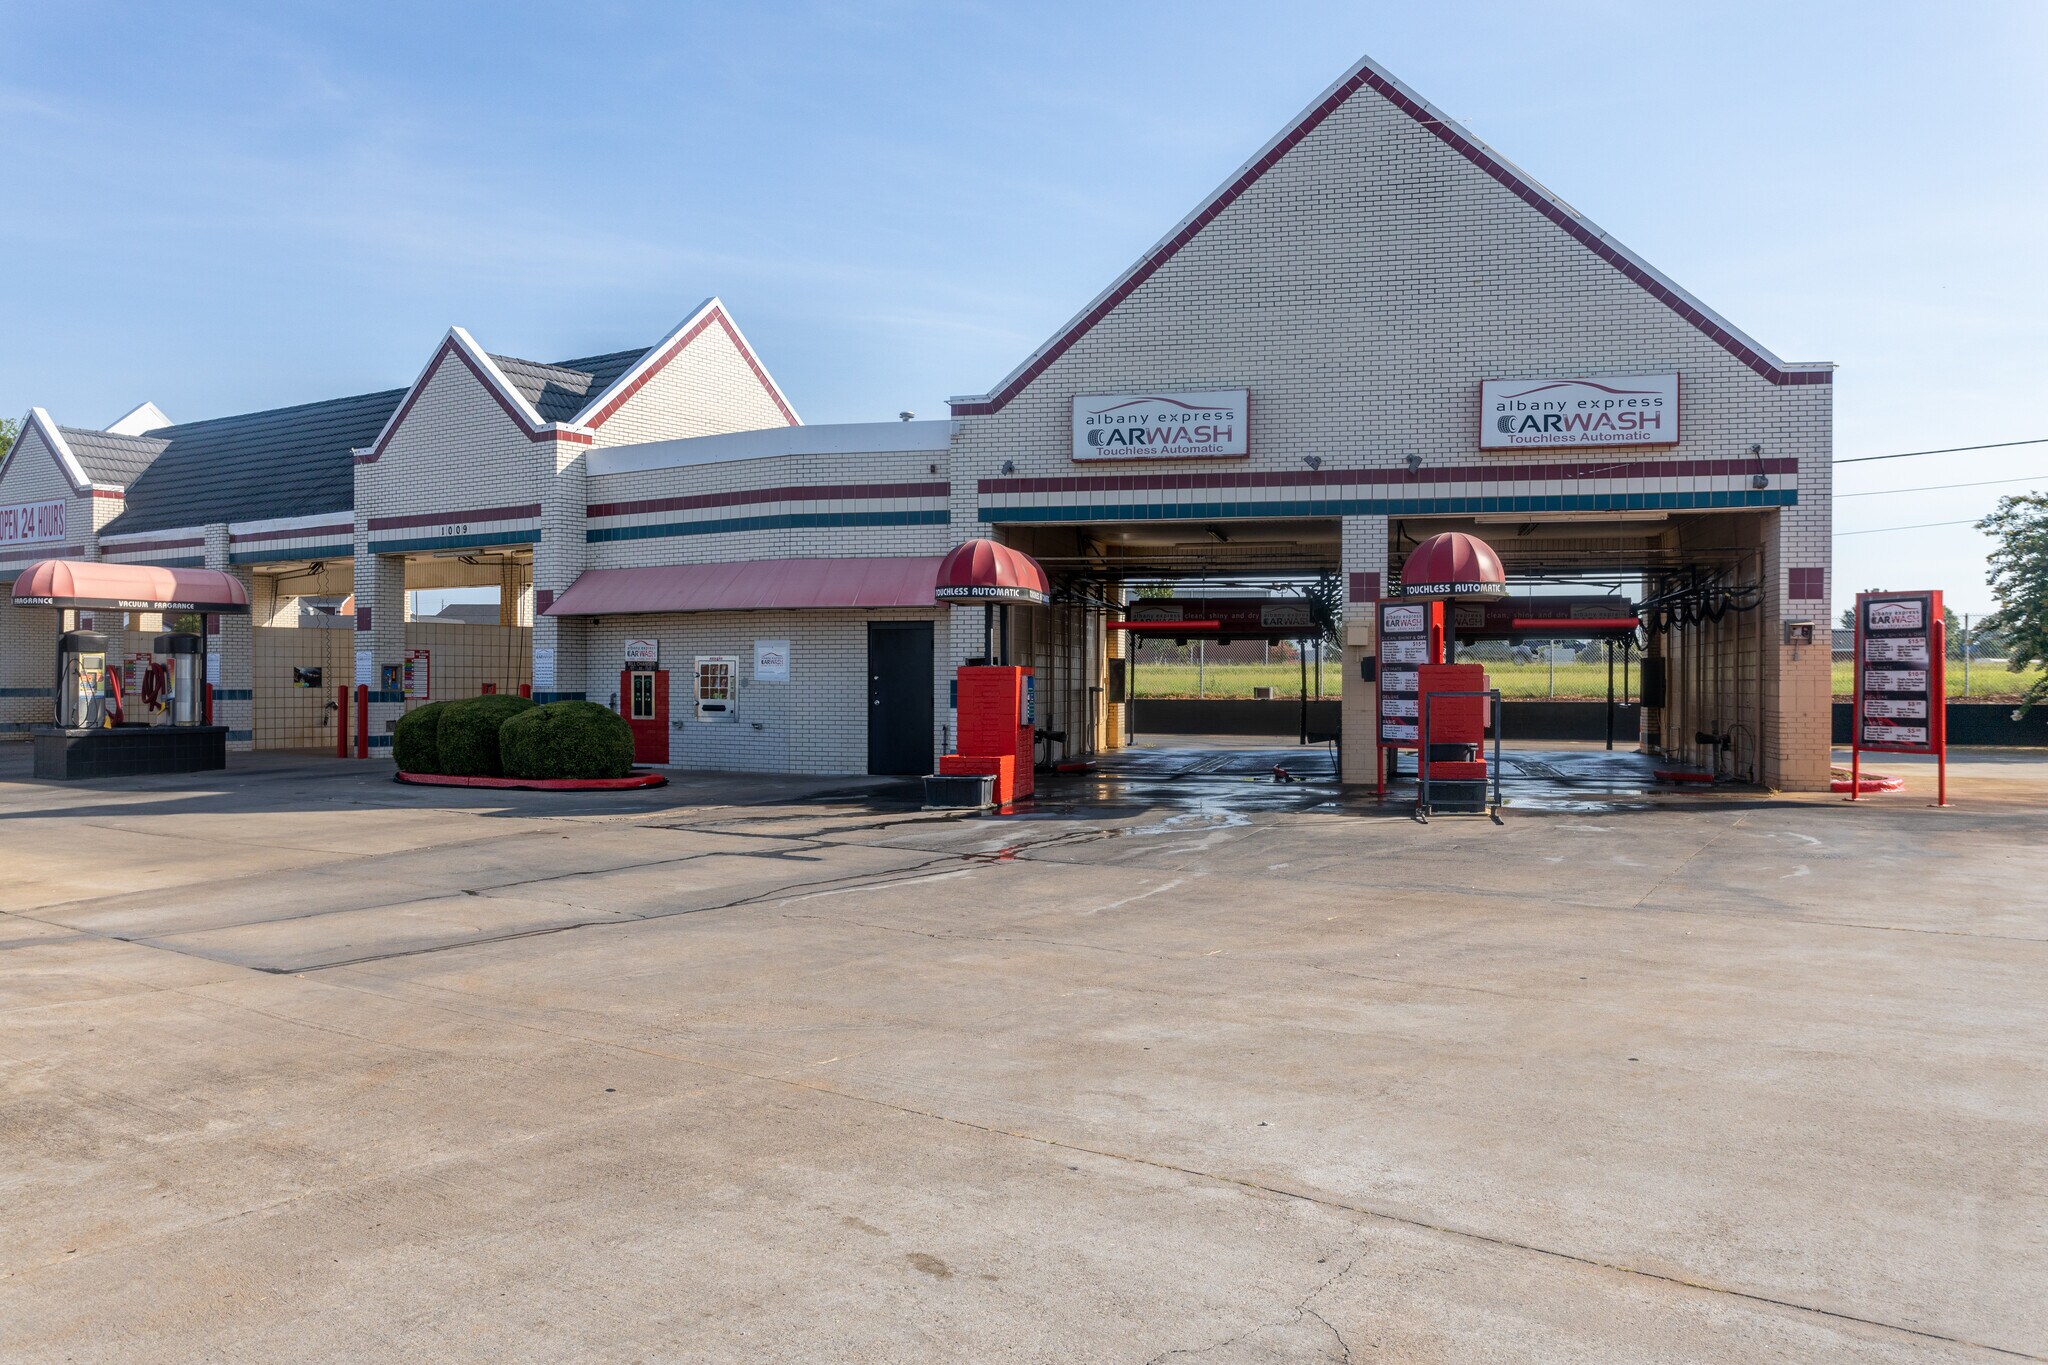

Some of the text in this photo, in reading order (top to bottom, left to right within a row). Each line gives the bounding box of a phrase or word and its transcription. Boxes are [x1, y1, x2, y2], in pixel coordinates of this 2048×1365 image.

[1496, 397, 1663, 411] albany express
[1086, 411, 1234, 425] albany express
[1497, 410, 1661, 434] CARWASH
[1087, 425, 1232, 447] CARWASH
[1508, 431, 1650, 444] Touchless Automatic
[1096, 444, 1223, 456] Touchless Automatic
[0, 504, 64, 540] OPEN 24 HOURS
[441, 524, 468, 536] 1009
[935, 587, 968, 597] TOUCHLESS
[971, 587, 1020, 597] AUTOMATIC
[1406, 583, 1501, 595] TOUCHLESS AUTOMATIC
[118, 600, 195, 610] VACUUM FRAGRANCE
[1247, 611, 1260, 620] dry
